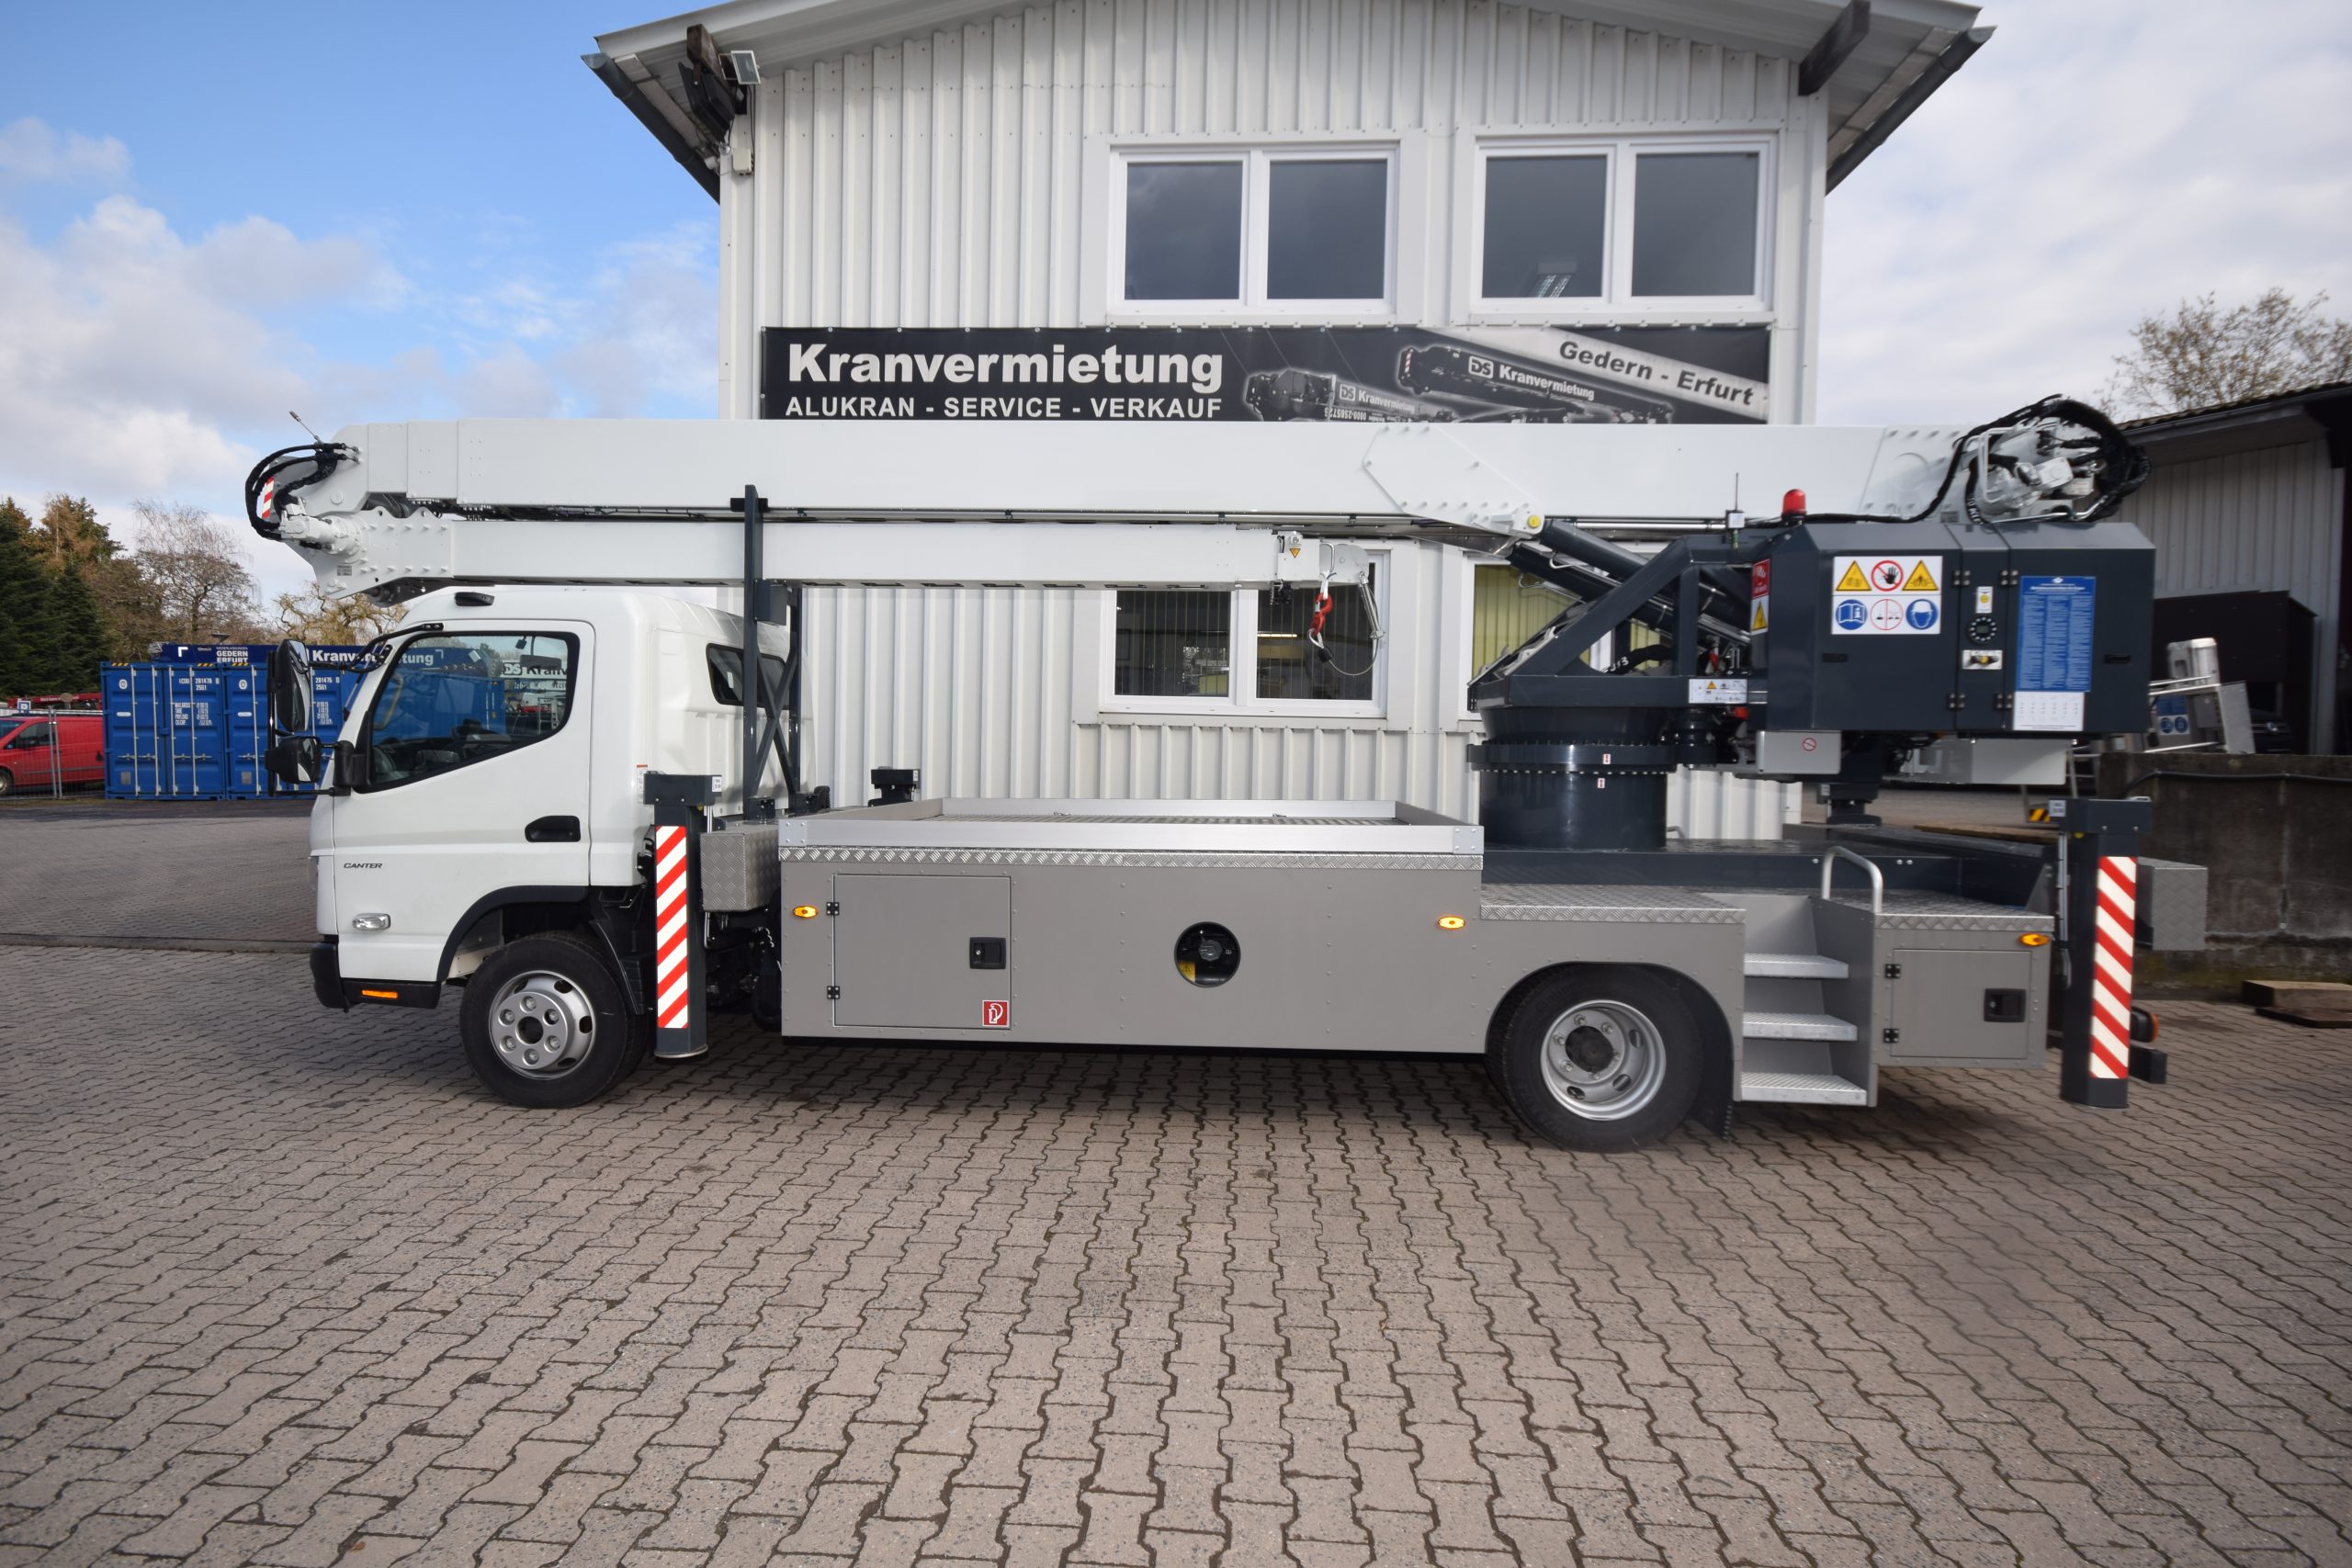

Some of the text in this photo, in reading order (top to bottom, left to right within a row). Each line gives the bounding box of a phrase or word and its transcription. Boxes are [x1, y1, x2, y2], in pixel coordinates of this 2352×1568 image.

[788, 344, 1223, 394] Kranvermietung
[1471, 357, 1595, 401] DS Kranvermietung
[1560, 341, 1653, 380] Gedern
[1677, 370, 1754, 406] Erfurt
[786, 397, 914, 417] ALUKRAN
[944, 397, 1062, 417] SERVICE
[1091, 397, 1223, 418] VERKAUF
